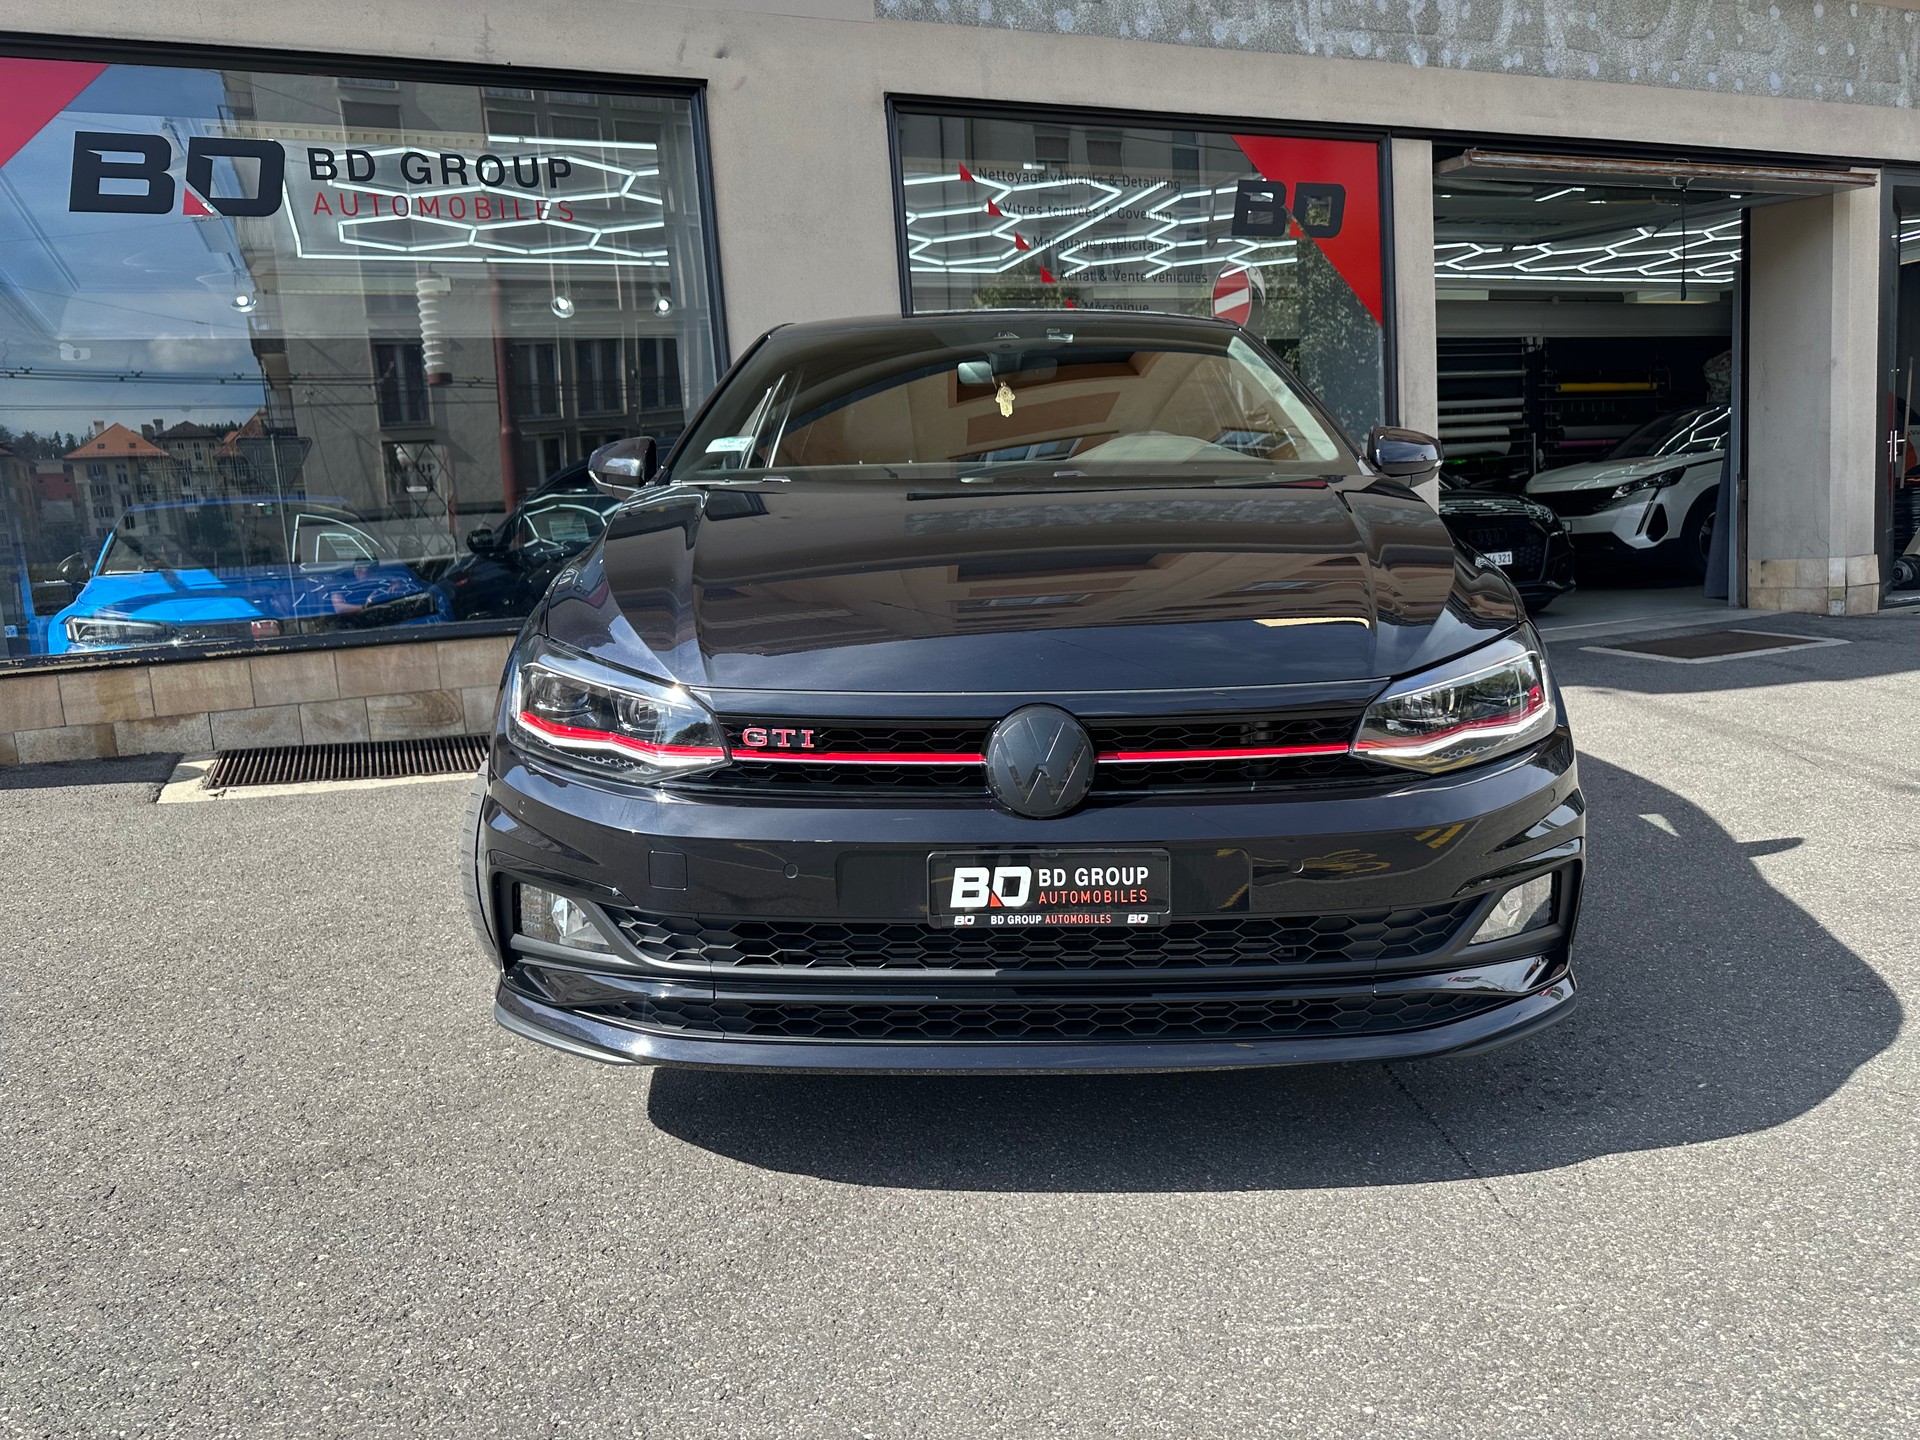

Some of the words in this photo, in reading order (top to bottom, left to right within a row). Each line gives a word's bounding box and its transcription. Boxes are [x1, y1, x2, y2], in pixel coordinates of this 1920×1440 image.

[69, 131, 285, 217] BD
[307, 147, 376, 182] BD
[400, 152, 572, 188] GROUP
[978, 168, 1046, 184] Nettoyage
[1050, 172, 1104, 185] véhicule
[1108, 174, 1118, 187] &
[313, 192, 574, 222] AUTOMOBILES
[1003, 202, 1042, 215] Vitres
[1048, 203, 1099, 218] teintées
[1104, 206, 1113, 218] &
[1117, 207, 1173, 223] Covering
[1231, 179, 1346, 238] BD
[1033, 236, 1096, 253] Marquage
[1101, 238, 1171, 252] publicitaire
[1059, 270, 1094, 282] Achat
[1098, 270, 1108, 282] &
[1112, 270, 1147, 283] Vente
[742, 727, 815, 748] GTI
[950, 866, 1032, 908] BD
[1038, 868, 1067, 887] BD
[1074, 867, 1149, 887] GROUP
[1038, 889, 1148, 905] AUTOMOBILES
[990, 915, 1005, 925] BD
[1007, 915, 1042, 925] GROUP
[1045, 914, 1112, 925] AUTOMOBILES
